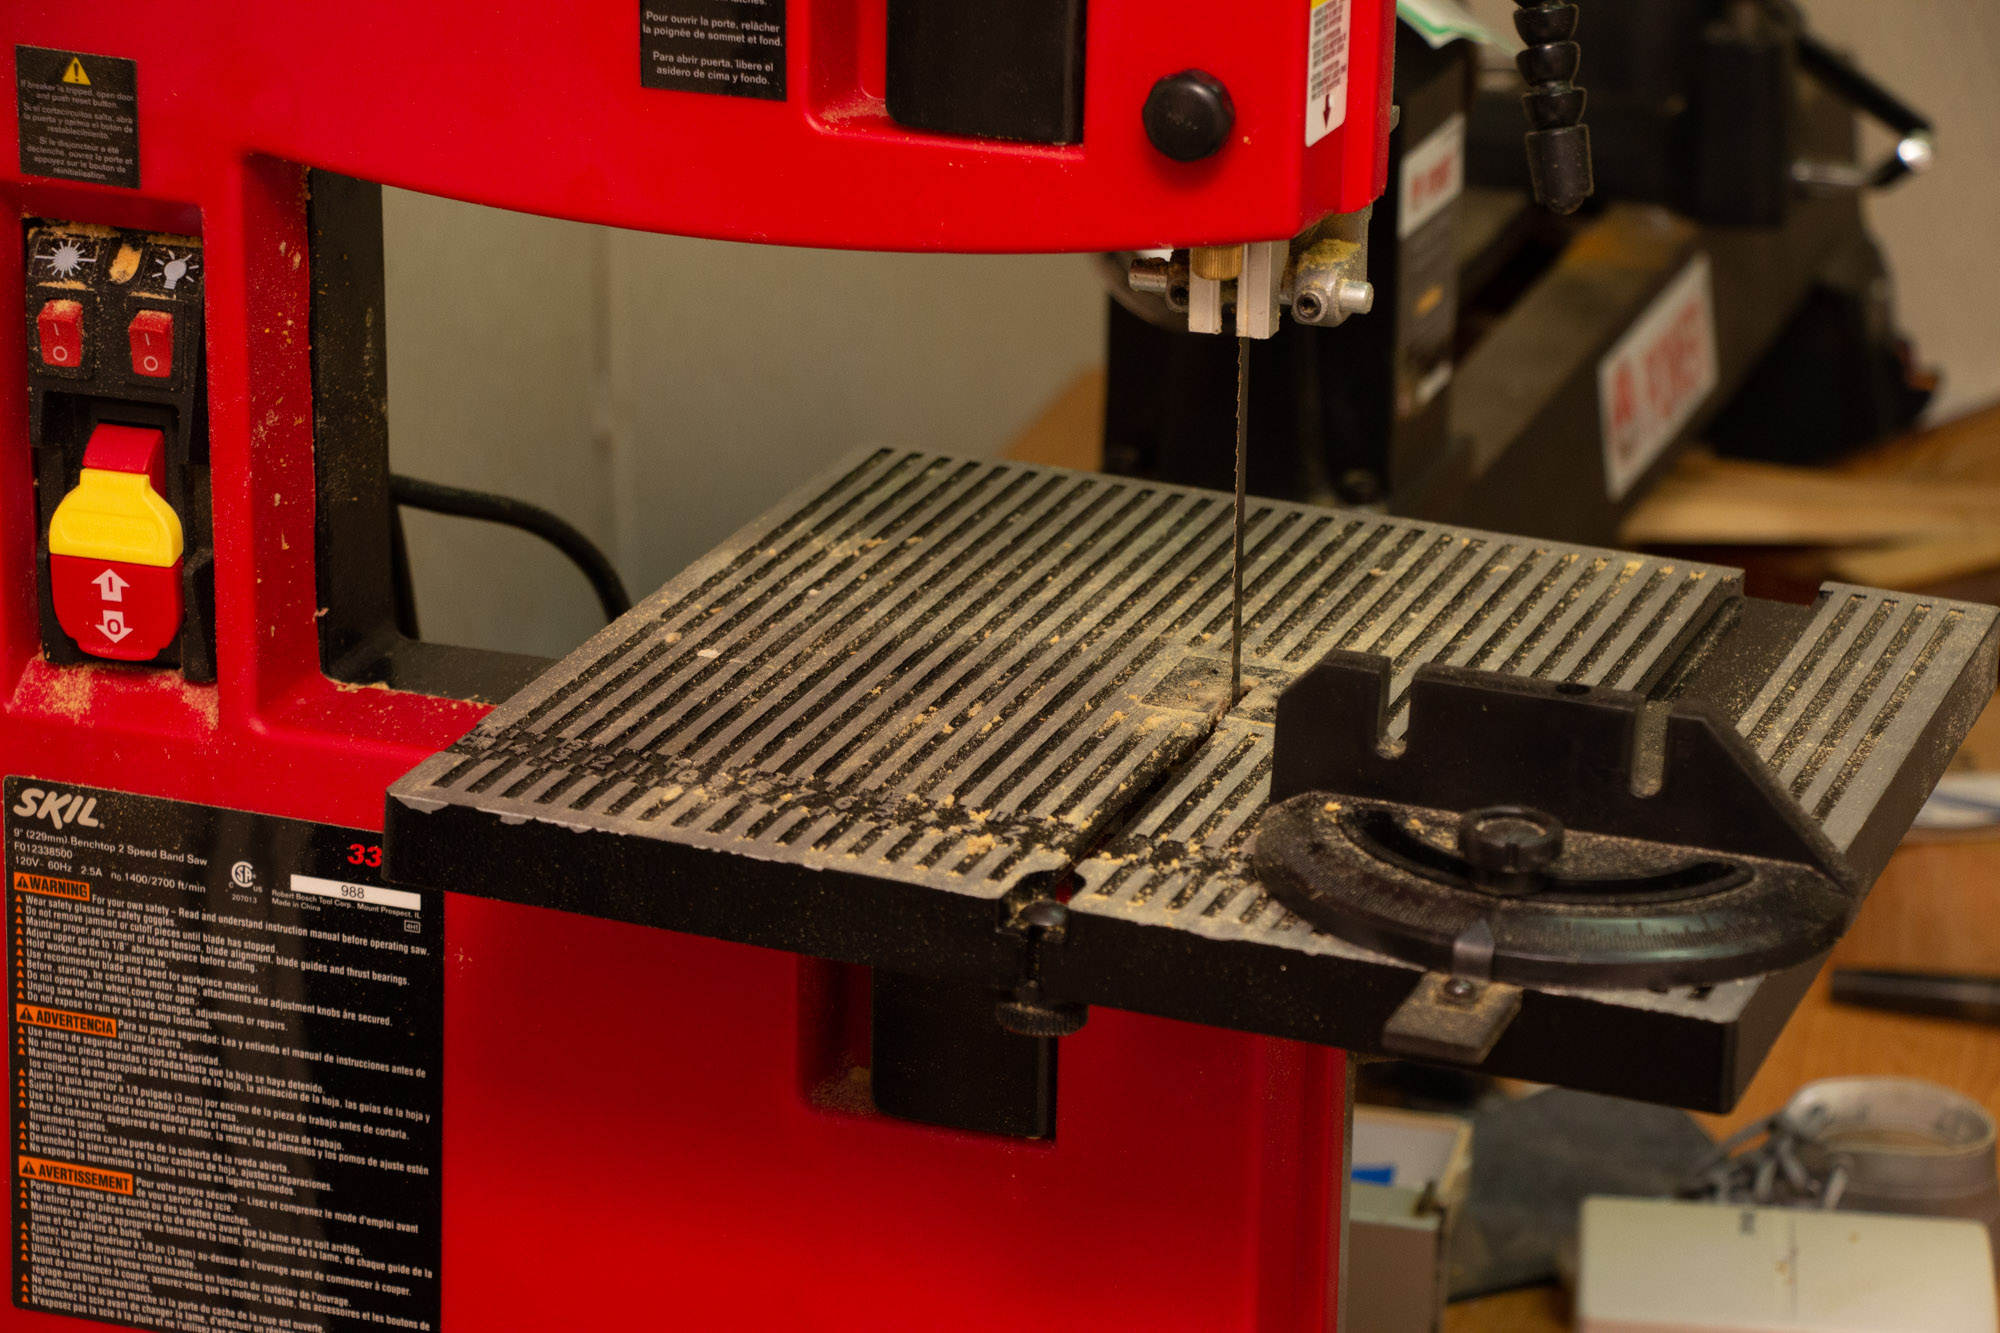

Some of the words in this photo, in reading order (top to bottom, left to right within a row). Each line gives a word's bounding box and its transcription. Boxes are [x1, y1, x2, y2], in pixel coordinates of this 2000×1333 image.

[646, 11, 668, 22] Pour
[671, 14, 697, 25] ouvrir
[701, 17, 709, 26] la
[643, 24, 651, 33] la
[654, 25, 691, 39] poignée
[694, 29, 705, 39] de
[708, 31, 745, 43] sommet
[748, 35, 757, 44] et
[760, 36, 783, 47] fond.
[653, 51, 674, 62] Para
[677, 54, 698, 64] abrir
[736, 60, 762, 71] libere
[765, 63, 773, 72] el
[657, 65, 691, 77] asidero
[694, 69, 705, 78] de
[708, 70, 730, 81] cima
[733, 75, 738, 83] y
[741, 74, 769, 85] fondo.
[96, 92, 115, 100] open
[117, 93, 133, 101] door
[13, 788, 100, 829] SKIL
[14, 828, 24, 838] 9"
[71, 837, 116, 854] Benchtop
[119, 844, 124, 853] 2
[127, 845, 157, 860] Speed
[160, 850, 184, 862] Band
[187, 855, 207, 866] Saw
[15, 842, 73, 859] F012338500
[30, 877, 87, 898] WARNING
[48, 861, 72, 873] 60Hz
[81, 866, 102, 877] 2.5A
[125, 873, 175, 889] 1400/2700
[178, 881, 206, 893] ft/min
[232, 894, 257, 904] 207013
[272, 890, 294, 899] Robert
[296, 894, 317, 903] Bosch
[320, 897, 333, 905] Tool
[357, 903, 379, 912] Mount
[342, 885, 365, 899] 988
[26, 895, 47, 907] Wear
[48, 899, 73, 913] safety
[74, 903, 105, 918] glasses
[107, 910, 115, 918] or
[117, 910, 141, 924] safety
[272, 898, 291, 907] Made
[301, 903, 321, 912] China
[93, 895, 105, 905] For
[107, 899, 125, 910] your
[127, 902, 143, 911] own
[145, 903, 170, 917] safety
[178, 908, 200, 920] Read
[201, 912, 216, 922] and
[218, 914, 263, 930] understand
[265, 922, 308, 937] instruction
[310, 929, 340, 942] manual
[342, 934, 368, 946] before
[370, 938, 409, 954] operating
[410, 946, 430, 956] saw.
[27, 917, 61, 930] Maintain
[63, 924, 89, 937] proper
[91, 927, 135, 944] adjustment
[147, 936, 169, 948] blade
[206, 945, 229, 957] blade
[276, 957, 299, 969] blade
[300, 961, 328, 975] guides
[330, 965, 345, 976] and
[346, 968, 370, 980] thrust
[372, 972, 410, 988] bearings.
[27, 938, 45, 949] Hold
[47, 941, 87, 958] workpiece
[89, 948, 113, 962] firmly
[114, 952, 144, 967] against
[27, 949, 42, 959] Use
[44, 951, 100, 969] recommended
[102, 961, 124, 973] blade
[126, 965, 141, 975] and
[143, 967, 167, 981] speed
[169, 972, 180, 982] for
[182, 974, 223, 990] workpiece
[225, 981, 261, 995] material.
[36, 1010, 113, 1035] ADVERTENCIA
[119, 1031, 146, 1043] utilizar
[148, 1036, 156, 1045] la
[157, 1037, 183, 1050] sierra.
[119, 1020, 137, 1031] Para
[138, 1025, 148, 1033] su
[150, 1025, 176, 1039] propia
[221, 1036, 237, 1047] Lea
[238, 1041, 243, 1050] y
[245, 1040, 280, 1054] entienda
[292, 1048, 322, 1061] manual
[324, 1053, 334, 1063] de
[336, 1055, 390, 1072] instrucciones
[392, 1064, 414, 1076] antes
[416, 1068, 426, 1078] de
[39, 1164, 130, 1192] AVERTISSEMENT
[247, 1196, 268, 1208] Lisez
